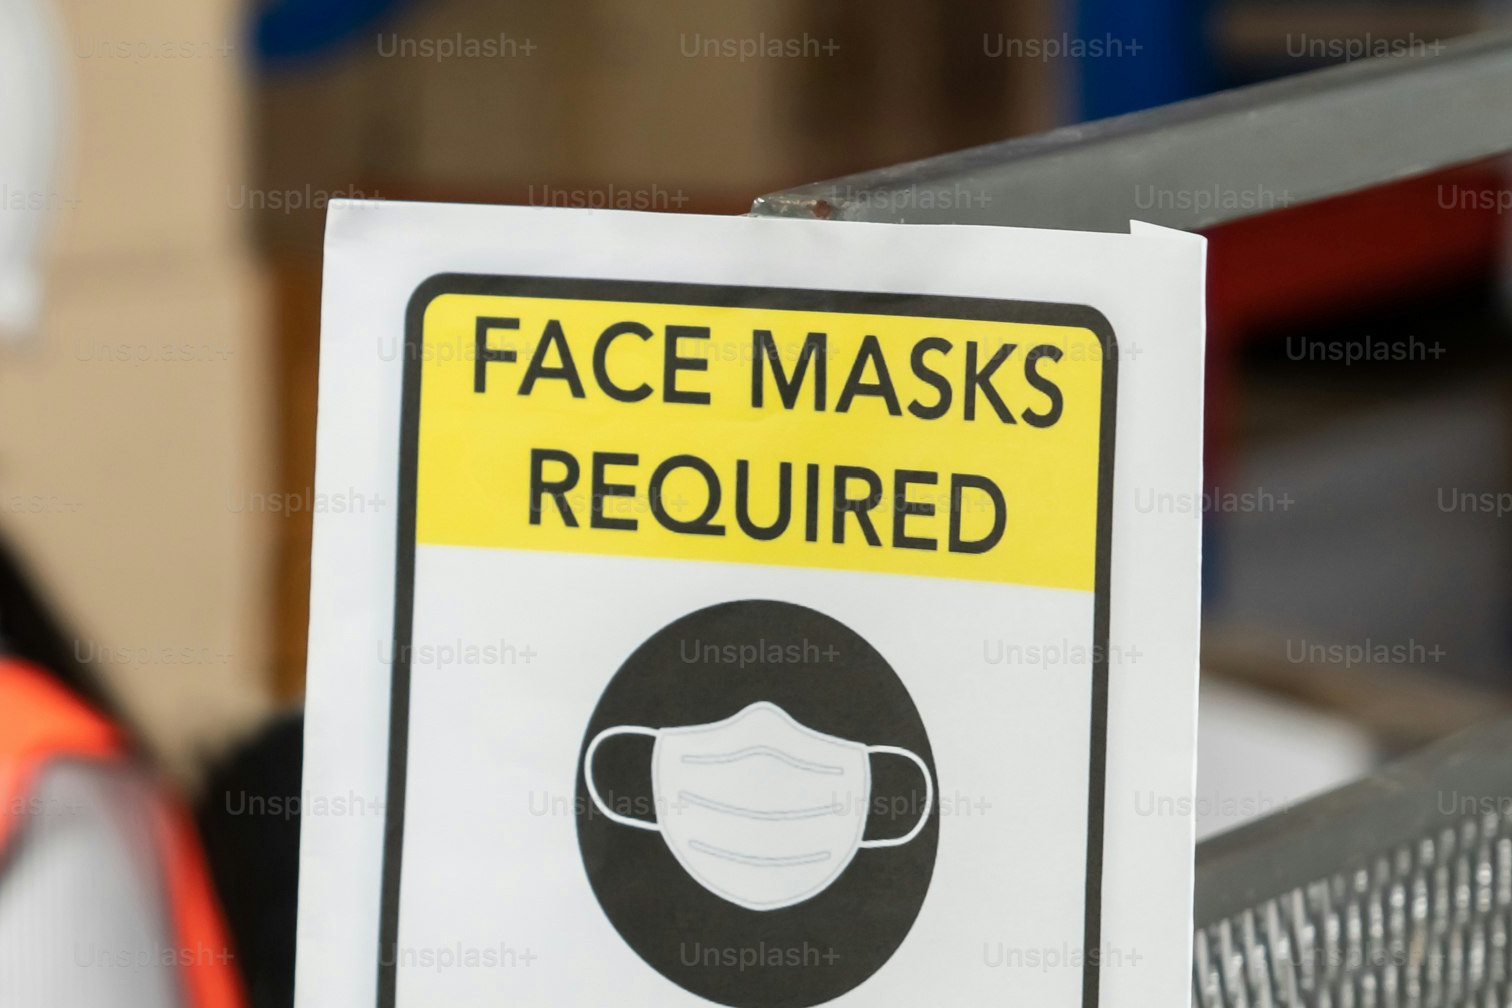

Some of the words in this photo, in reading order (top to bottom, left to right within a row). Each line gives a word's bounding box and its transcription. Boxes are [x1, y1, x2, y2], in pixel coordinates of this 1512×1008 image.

[474, 316, 711, 405] FACE
[751, 329, 1064, 429] MASKS
[529, 448, 1007, 555] REQUIRED
